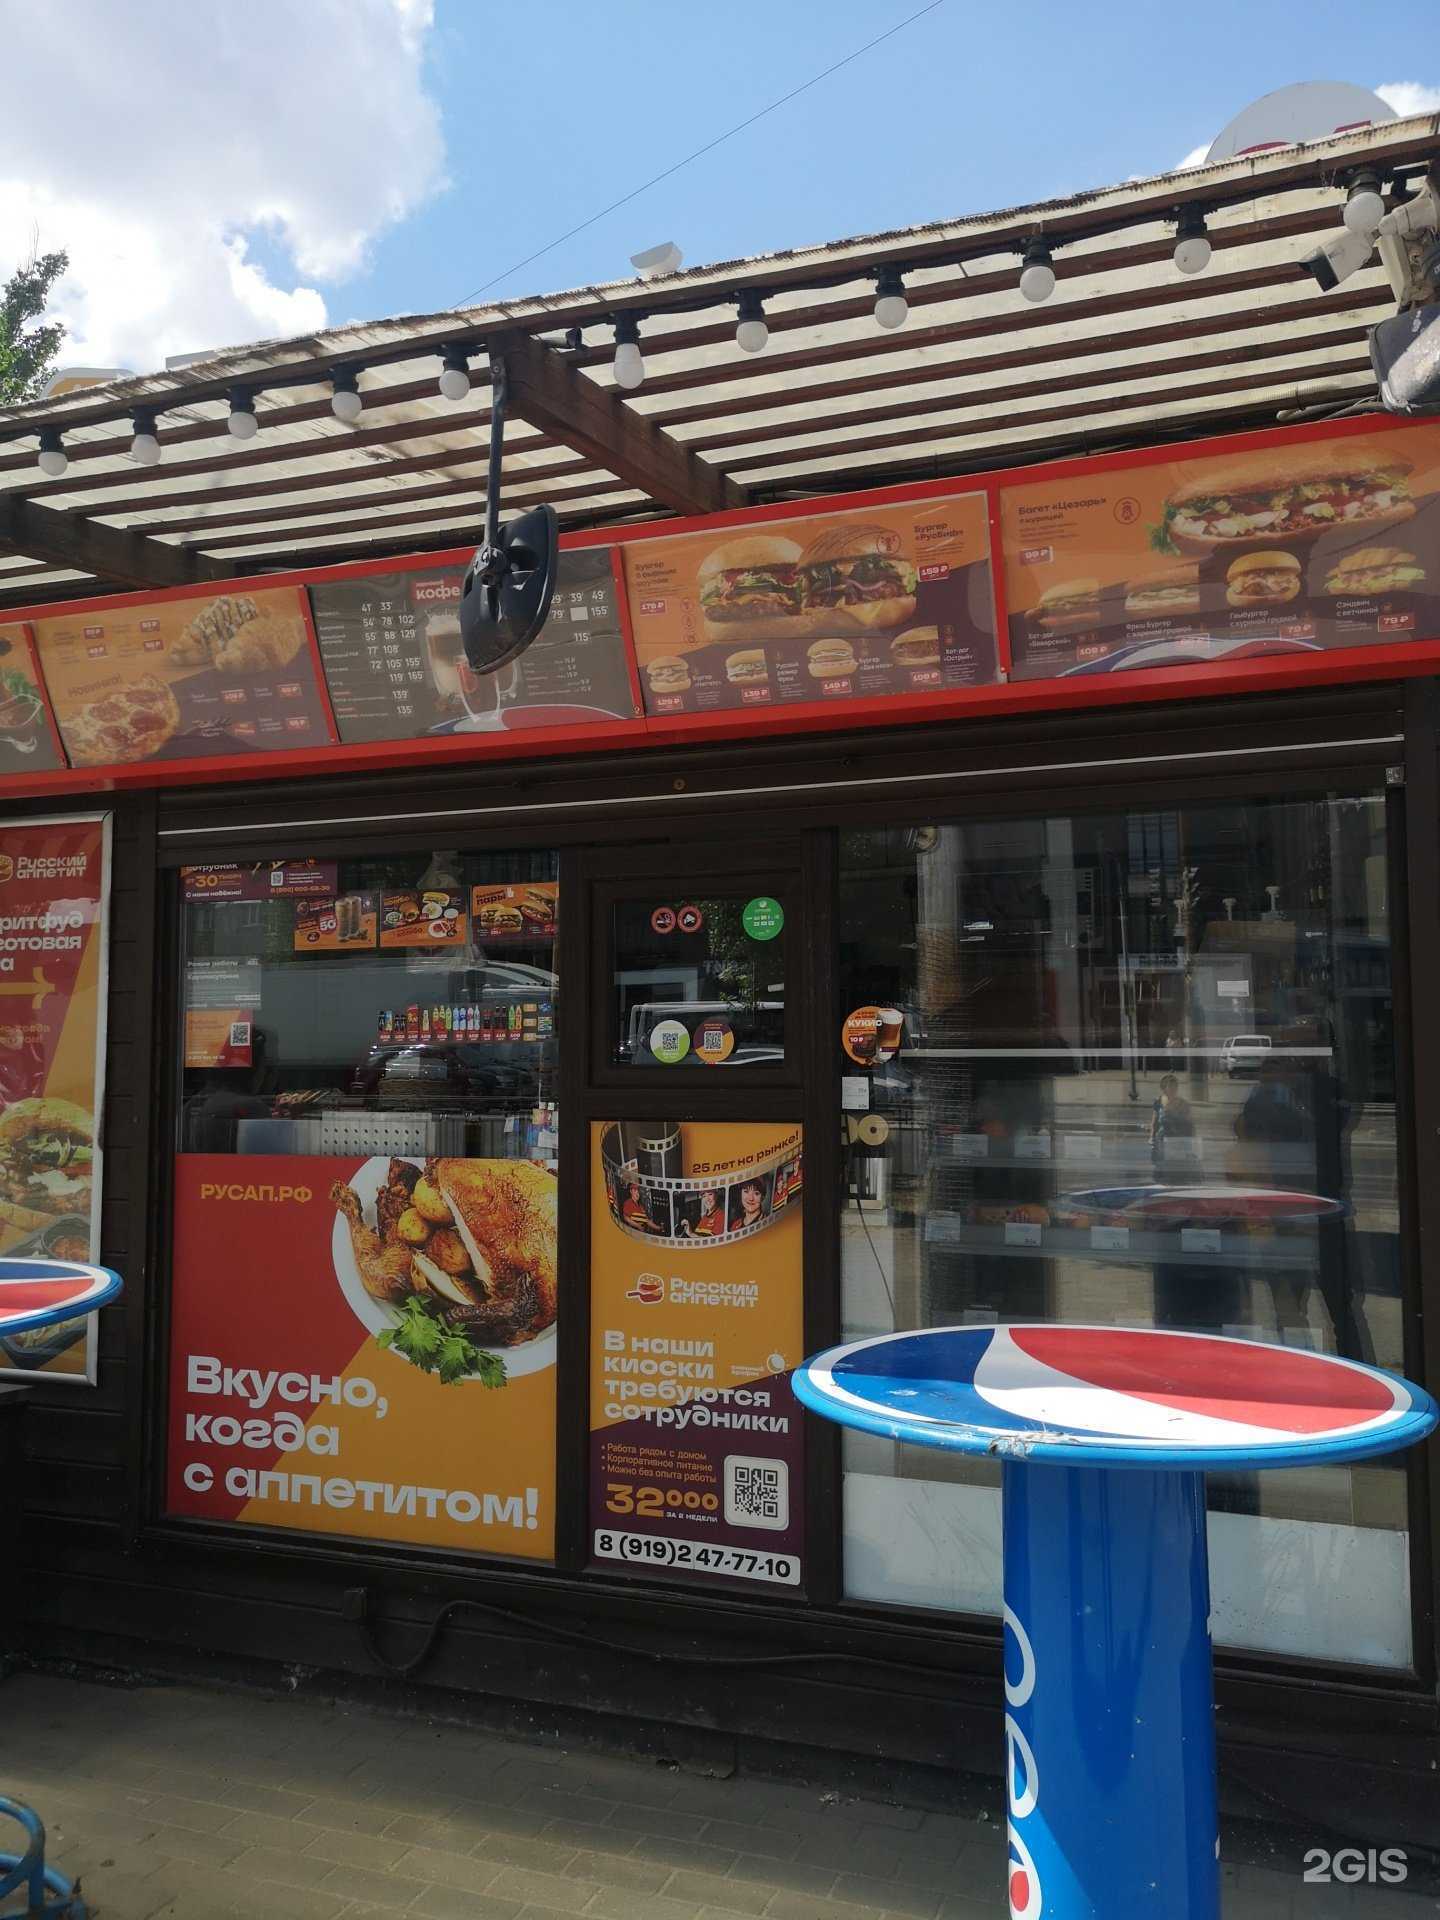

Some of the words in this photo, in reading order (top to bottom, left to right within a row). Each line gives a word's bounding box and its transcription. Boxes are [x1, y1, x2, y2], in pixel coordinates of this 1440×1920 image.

[416, 584, 461, 600] кофе
[17, 851, 88, 869] Русский
[16, 866, 87, 879] аппетит
[195, 875, 218, 888] 30
[692, 1162, 710, 1174] 25
[712, 1161, 737, 1172] лет
[737, 1155, 754, 1167] на
[756, 1130, 800, 1163] рынке!
[200, 1183, 313, 1204] РУСАП.РФ
[670, 1278, 759, 1297] Русский
[669, 1291, 759, 1309] аппетит
[604, 1330, 625, 1352] В
[631, 1336, 715, 1358] наши
[603, 1356, 715, 1380] киоски
[187, 1354, 388, 1420] Вкусно,
[604, 1378, 772, 1409] требуются
[604, 1402, 790, 1434] сотрудники
[185, 1411, 341, 1457] когда
[607, 1443, 637, 1454] Работа
[640, 1447, 667, 1458] рядом
[678, 1451, 707, 1460] домом
[607, 1453, 674, 1469] Корпоративное
[676, 1461, 713, 1472] питание
[607, 1464, 637, 1476] Можно
[639, 1467, 654, 1477] без
[656, 1470, 682, 1480] опыта
[684, 1473, 717, 1483] работы
[183, 1462, 214, 1493] с
[224, 1464, 540, 1531] аппетитом!
[599, 1534, 613, 1552] 8
